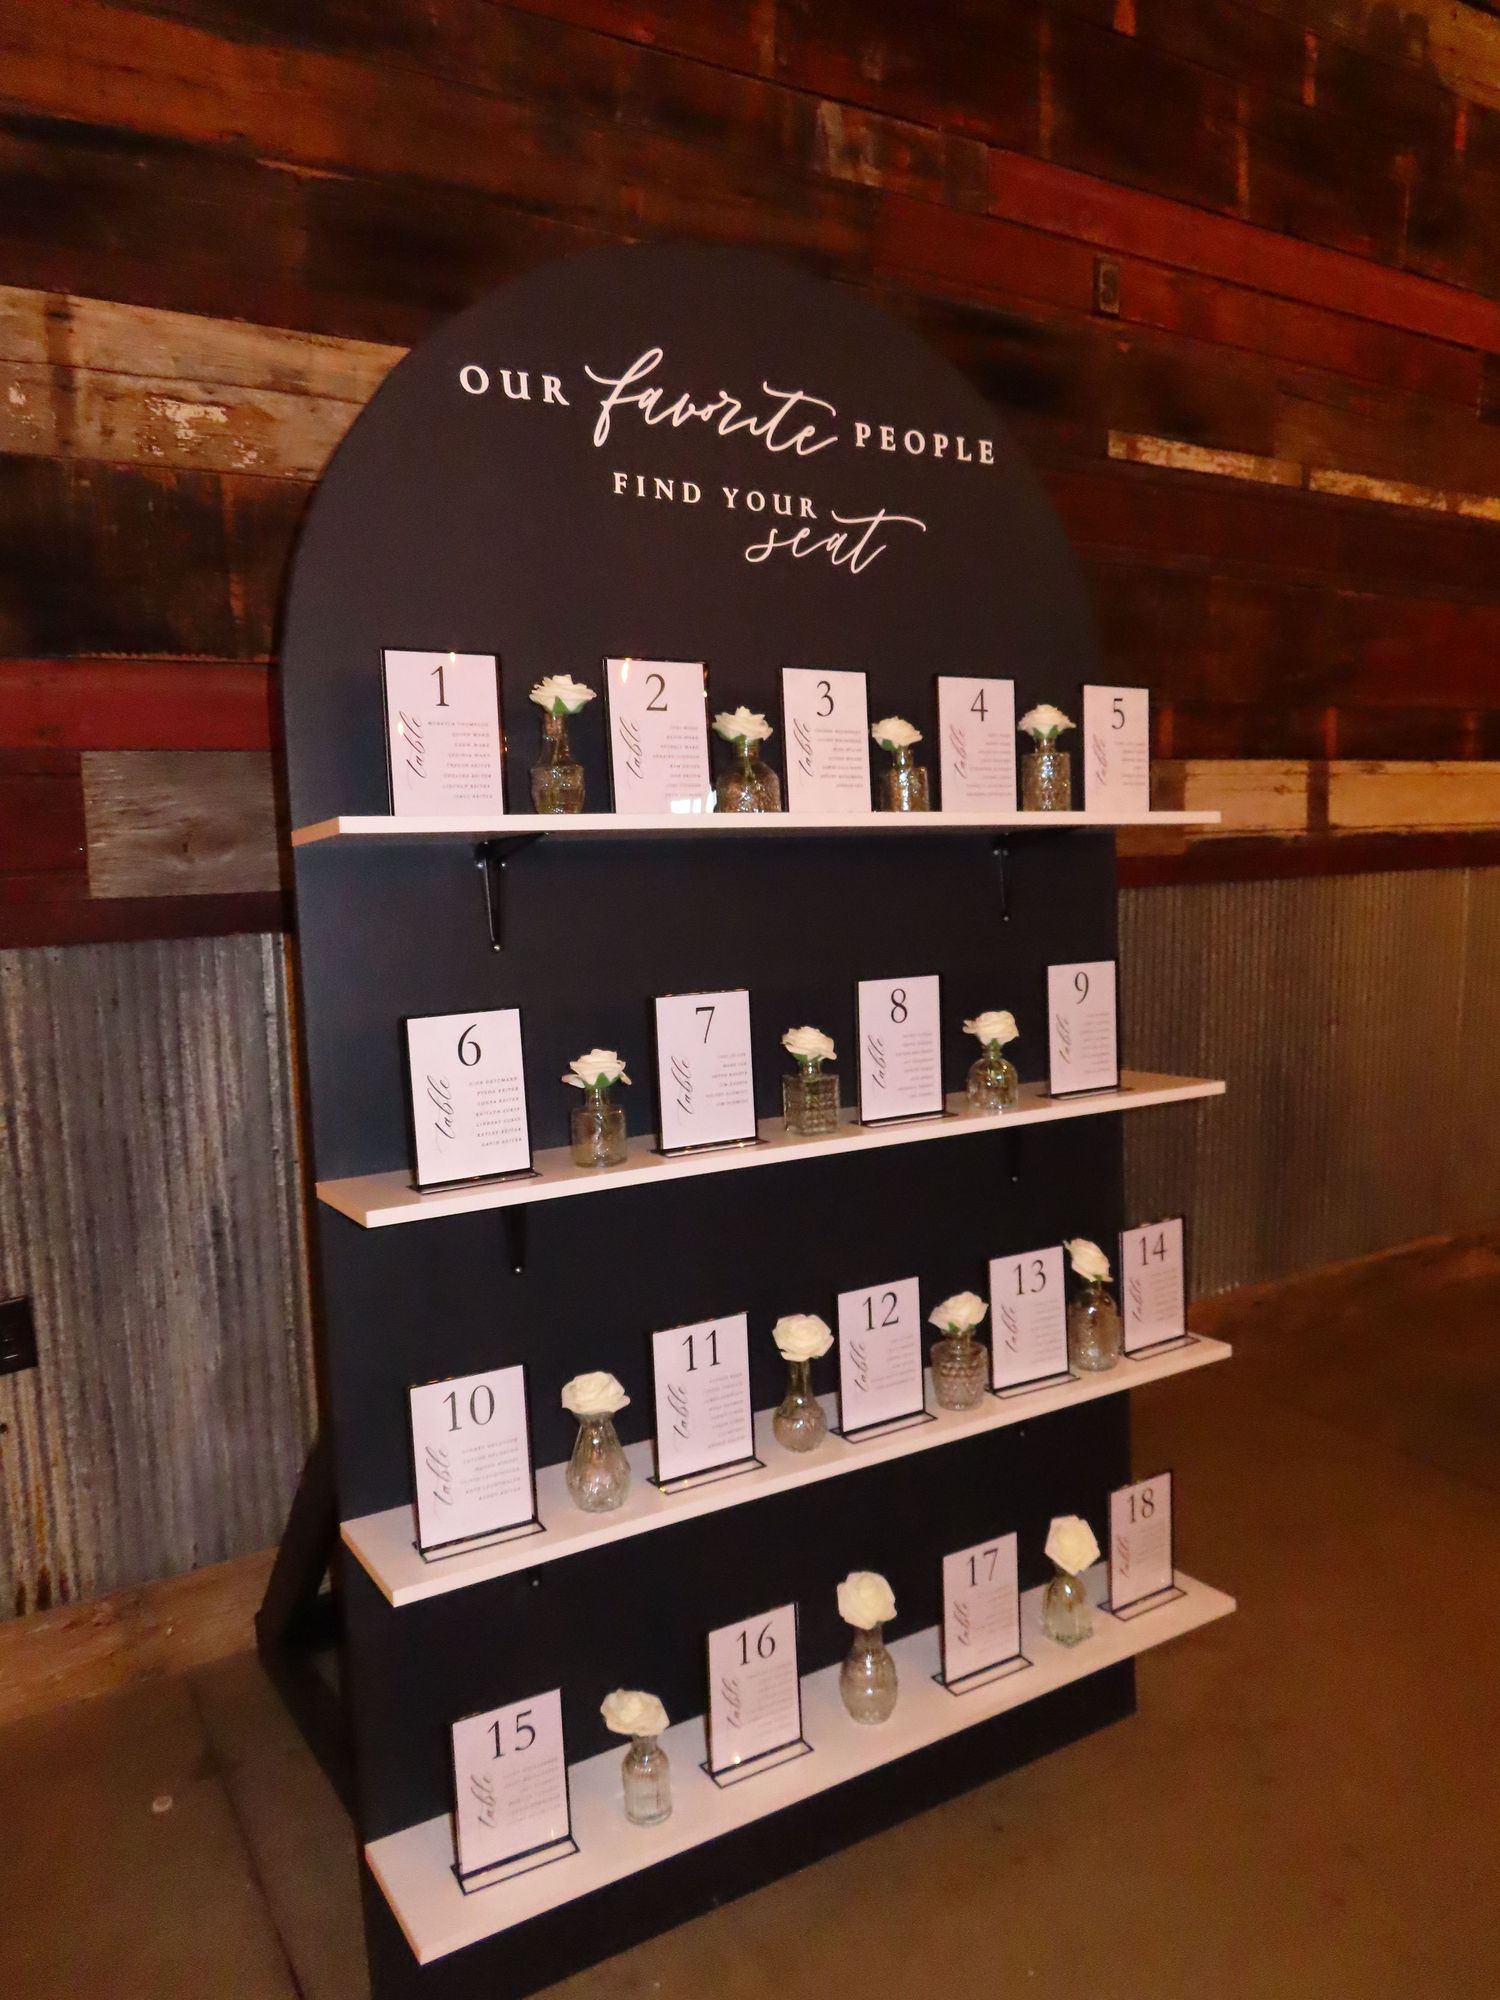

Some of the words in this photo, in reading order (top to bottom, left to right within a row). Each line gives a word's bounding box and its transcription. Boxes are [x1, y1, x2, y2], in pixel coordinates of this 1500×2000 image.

[459, 364, 570, 406] OUR
[583, 347, 838, 456] favorite
[854, 421, 996, 465] PEOPLE
[612, 471, 702, 504] FIND
[721, 486, 819, 520] YOUR
[744, 507, 927, 574] seat
[431, 666, 450, 706] 1
[645, 673, 668, 711] 2
[816, 680, 834, 717] 3
[970, 688, 988, 722] 4
[1111, 698, 1126, 730] 5
[890, 988, 908, 1024] 8
[1074, 971, 1089, 1005] 9
[457, 1023, 482, 1067] 6
[695, 1006, 716, 1044] 7
[1137, 1232, 1167, 1267] 14
[1012, 1259, 1048, 1296] 13
[862, 1291, 900, 1332] 12
[682, 1329, 721, 1372] 11
[442, 1384, 495, 1432] 10
[1126, 1487, 1155, 1524] 18
[967, 1548, 999, 1588] 17
[736, 1621, 776, 1667] 16
[488, 1709, 536, 1760] 15
